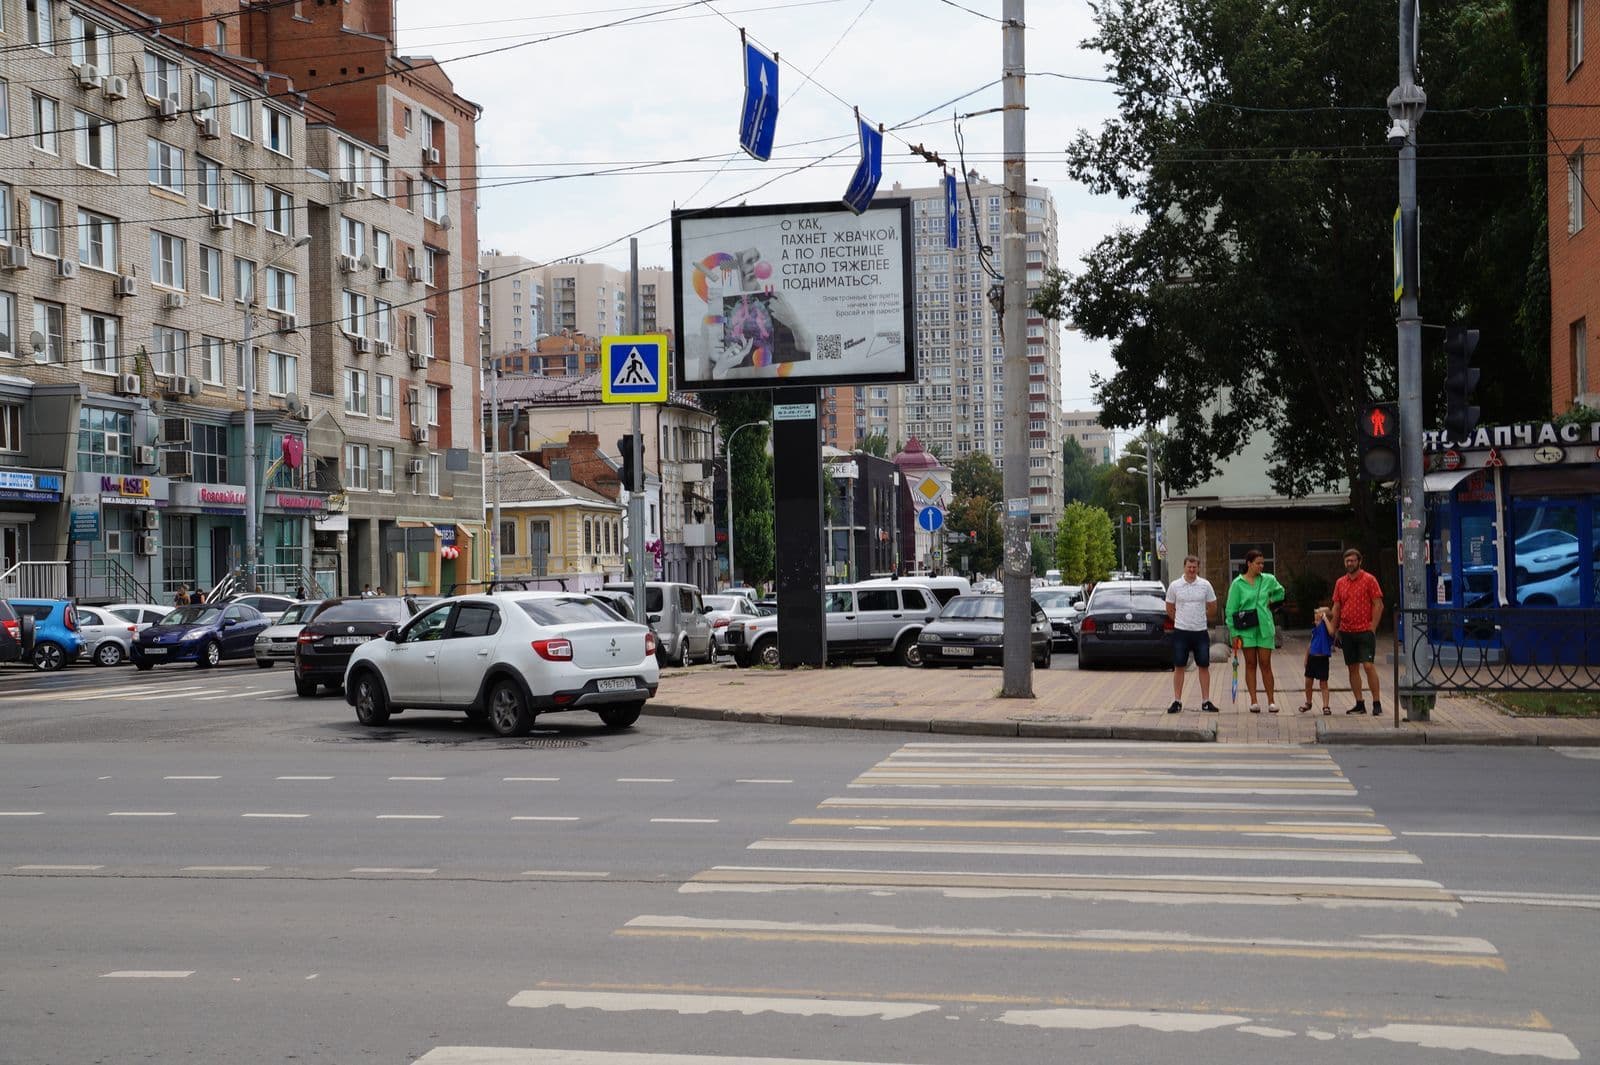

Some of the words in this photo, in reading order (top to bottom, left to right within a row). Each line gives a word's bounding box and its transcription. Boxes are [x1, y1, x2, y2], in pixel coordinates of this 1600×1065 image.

[781, 219, 792, 231] О
[798, 217, 823, 231] КАК,
[781, 232, 828, 246] ПАХНЕТ
[833, 226, 899, 243] ЖВАЧКОЙ,
[781, 249, 790, 261] А
[795, 247, 815, 260] ПО
[820, 244, 885, 259] ЛЕСТНИЦЕ
[782, 262, 826, 276] СТАЛО
[832, 258, 890, 273] ТЯЖЕЛЕЕ
[783, 274, 882, 292] ПОДНИМАТЬСЯ.
